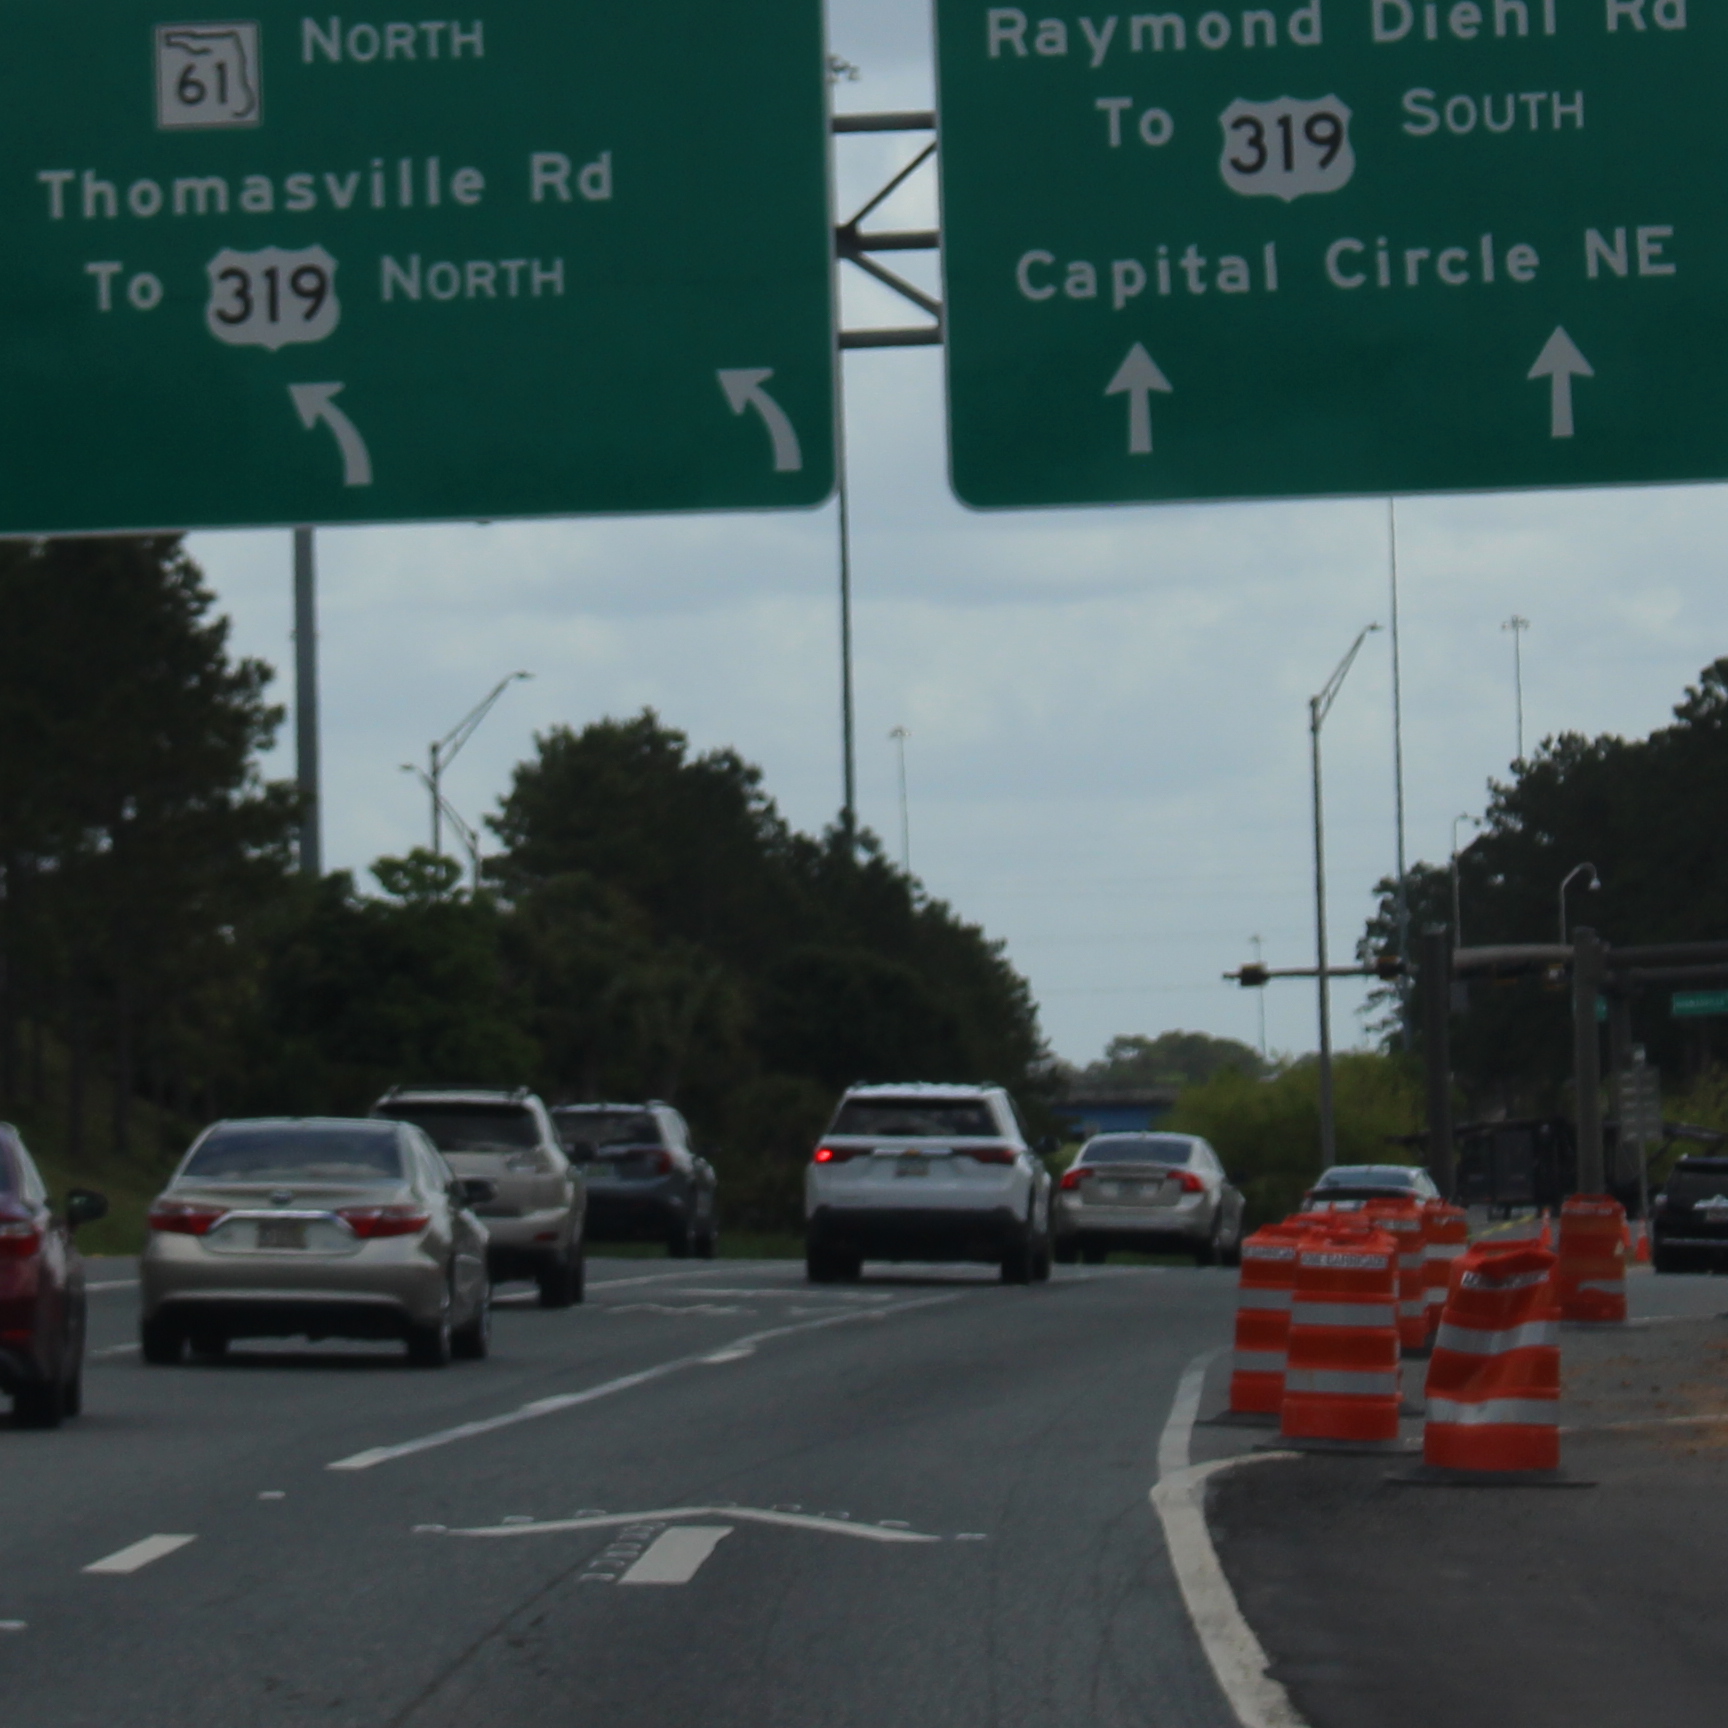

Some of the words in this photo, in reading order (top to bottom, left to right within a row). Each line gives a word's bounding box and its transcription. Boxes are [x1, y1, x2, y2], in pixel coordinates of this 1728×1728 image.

[176, 61, 229, 105] 61
[302, 17, 485, 64] NORTH
[1097, 97, 1174, 148] To
[1229, 112, 1346, 175] 319
[1402, 88, 1586, 137] SOUTH
[38, 157, 485, 220] Thomasville
[530, 152, 612, 202] Rd
[86, 262, 163, 312] To
[213, 264, 329, 327] 319
[381, 256, 564, 303] NORTH
[1016, 242, 1277, 309] Capital
[1324, 233, 1540, 290] Circle
[1585, 226, 1677, 279] NE
